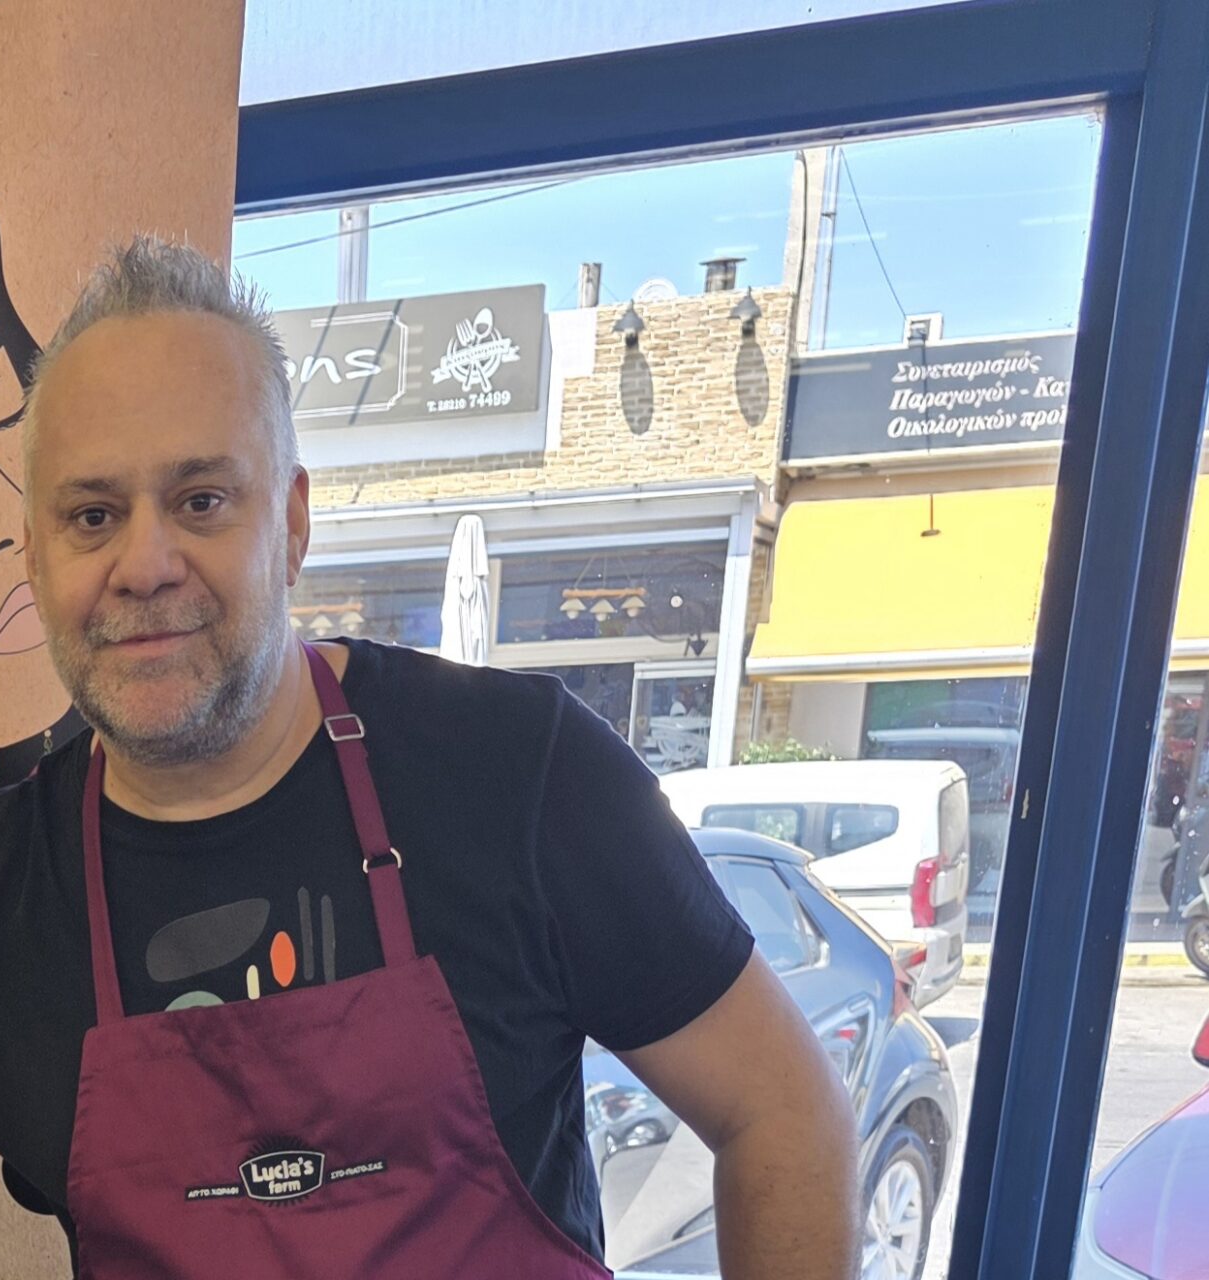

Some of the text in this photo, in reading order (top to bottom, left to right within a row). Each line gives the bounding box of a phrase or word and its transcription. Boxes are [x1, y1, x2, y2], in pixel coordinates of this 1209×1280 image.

[891, 351, 1042, 383] Συνεταιρισμός
[889, 381, 1016, 413] Παραγωγών
[888, 408, 1017, 438] Οικολογικών
[251, 1157, 314, 1183] Lucia's
[268, 1179, 301, 1195] farm
